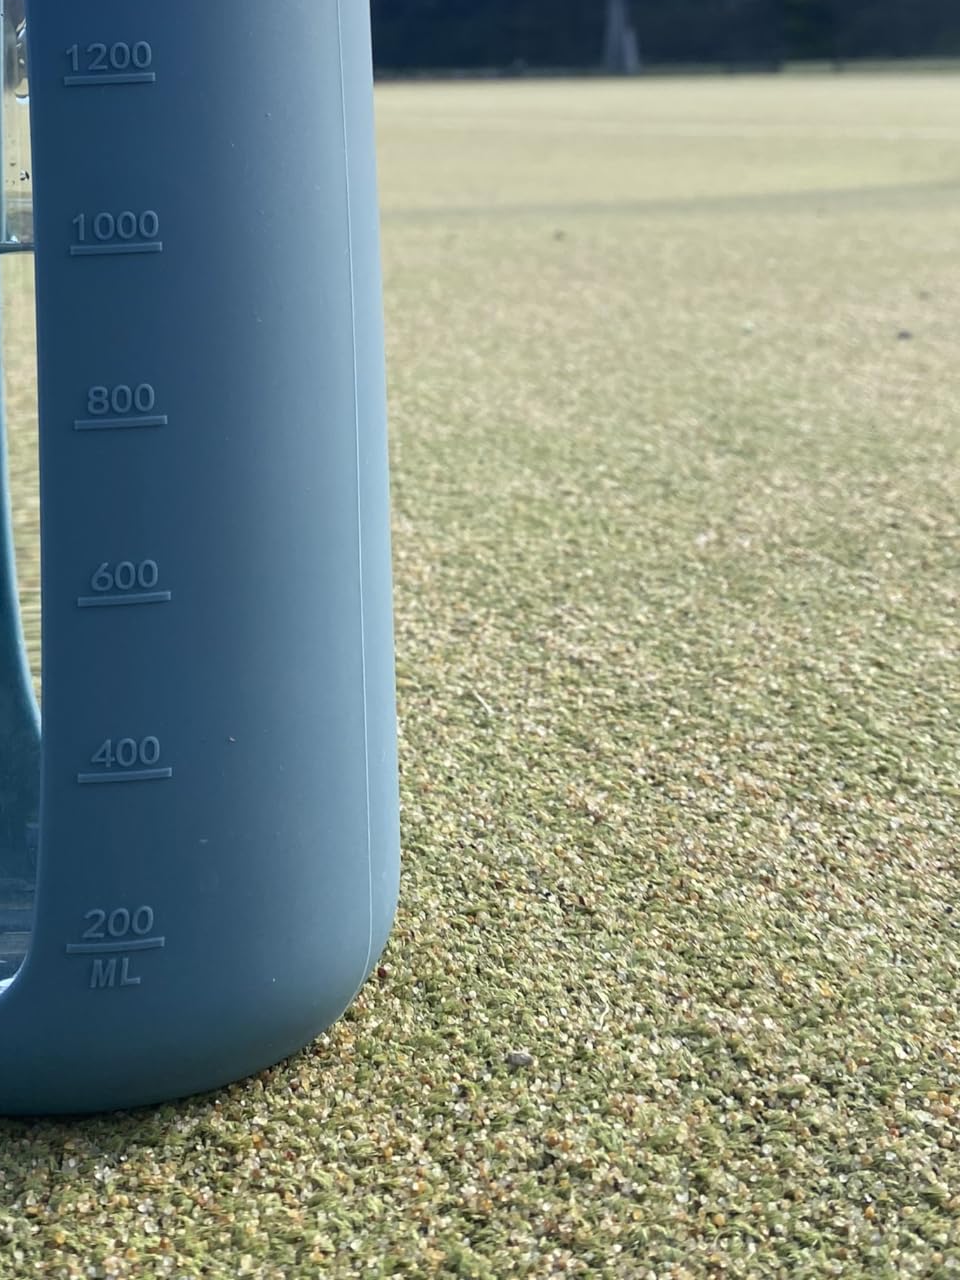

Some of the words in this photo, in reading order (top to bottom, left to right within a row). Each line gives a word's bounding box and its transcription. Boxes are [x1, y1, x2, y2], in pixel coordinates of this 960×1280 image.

[65, 40, 152, 71] 1200
[72, 210, 159, 241] 1000
[87, 383, 155, 414] 800
[91, 559, 159, 591] 600
[90, 735, 161, 768] 400
[81, 905, 154, 939] 200
[90, 957, 142, 989] ML
